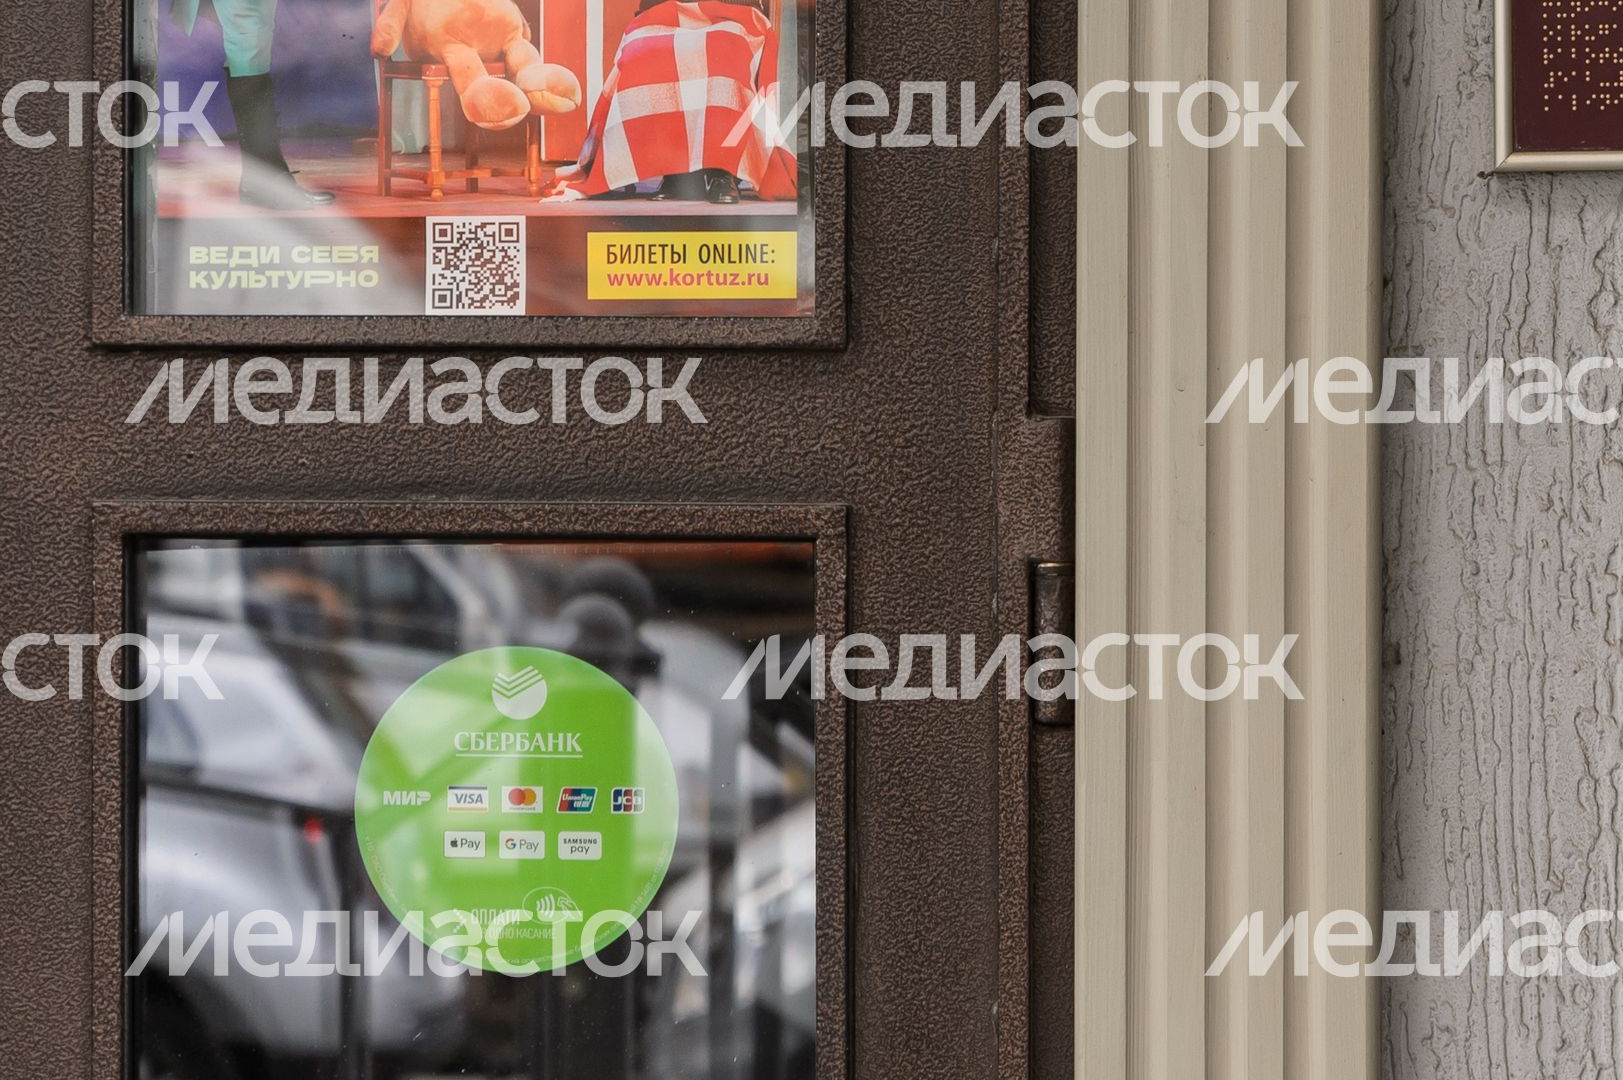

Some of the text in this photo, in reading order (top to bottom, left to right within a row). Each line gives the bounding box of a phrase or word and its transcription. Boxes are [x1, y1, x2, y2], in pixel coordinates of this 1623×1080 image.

[189, 245, 379, 268] ВЕДИ СЕБЯ
[606, 243, 776, 264] БИЛЕТЫ ONLINE:
[189, 270, 379, 290] КУЛЬТУРНО
[606, 268, 769, 287] www.kortuz.ru
[454, 731, 583, 753] СБЕРБАНК
[383, 790, 432, 807] МИР
[454, 793, 485, 805] VISA
[613, 794, 643, 807] JCB
[460, 838, 481, 851] Pay
[519, 838, 540, 851] Pay
[570, 845, 590, 855] pay
